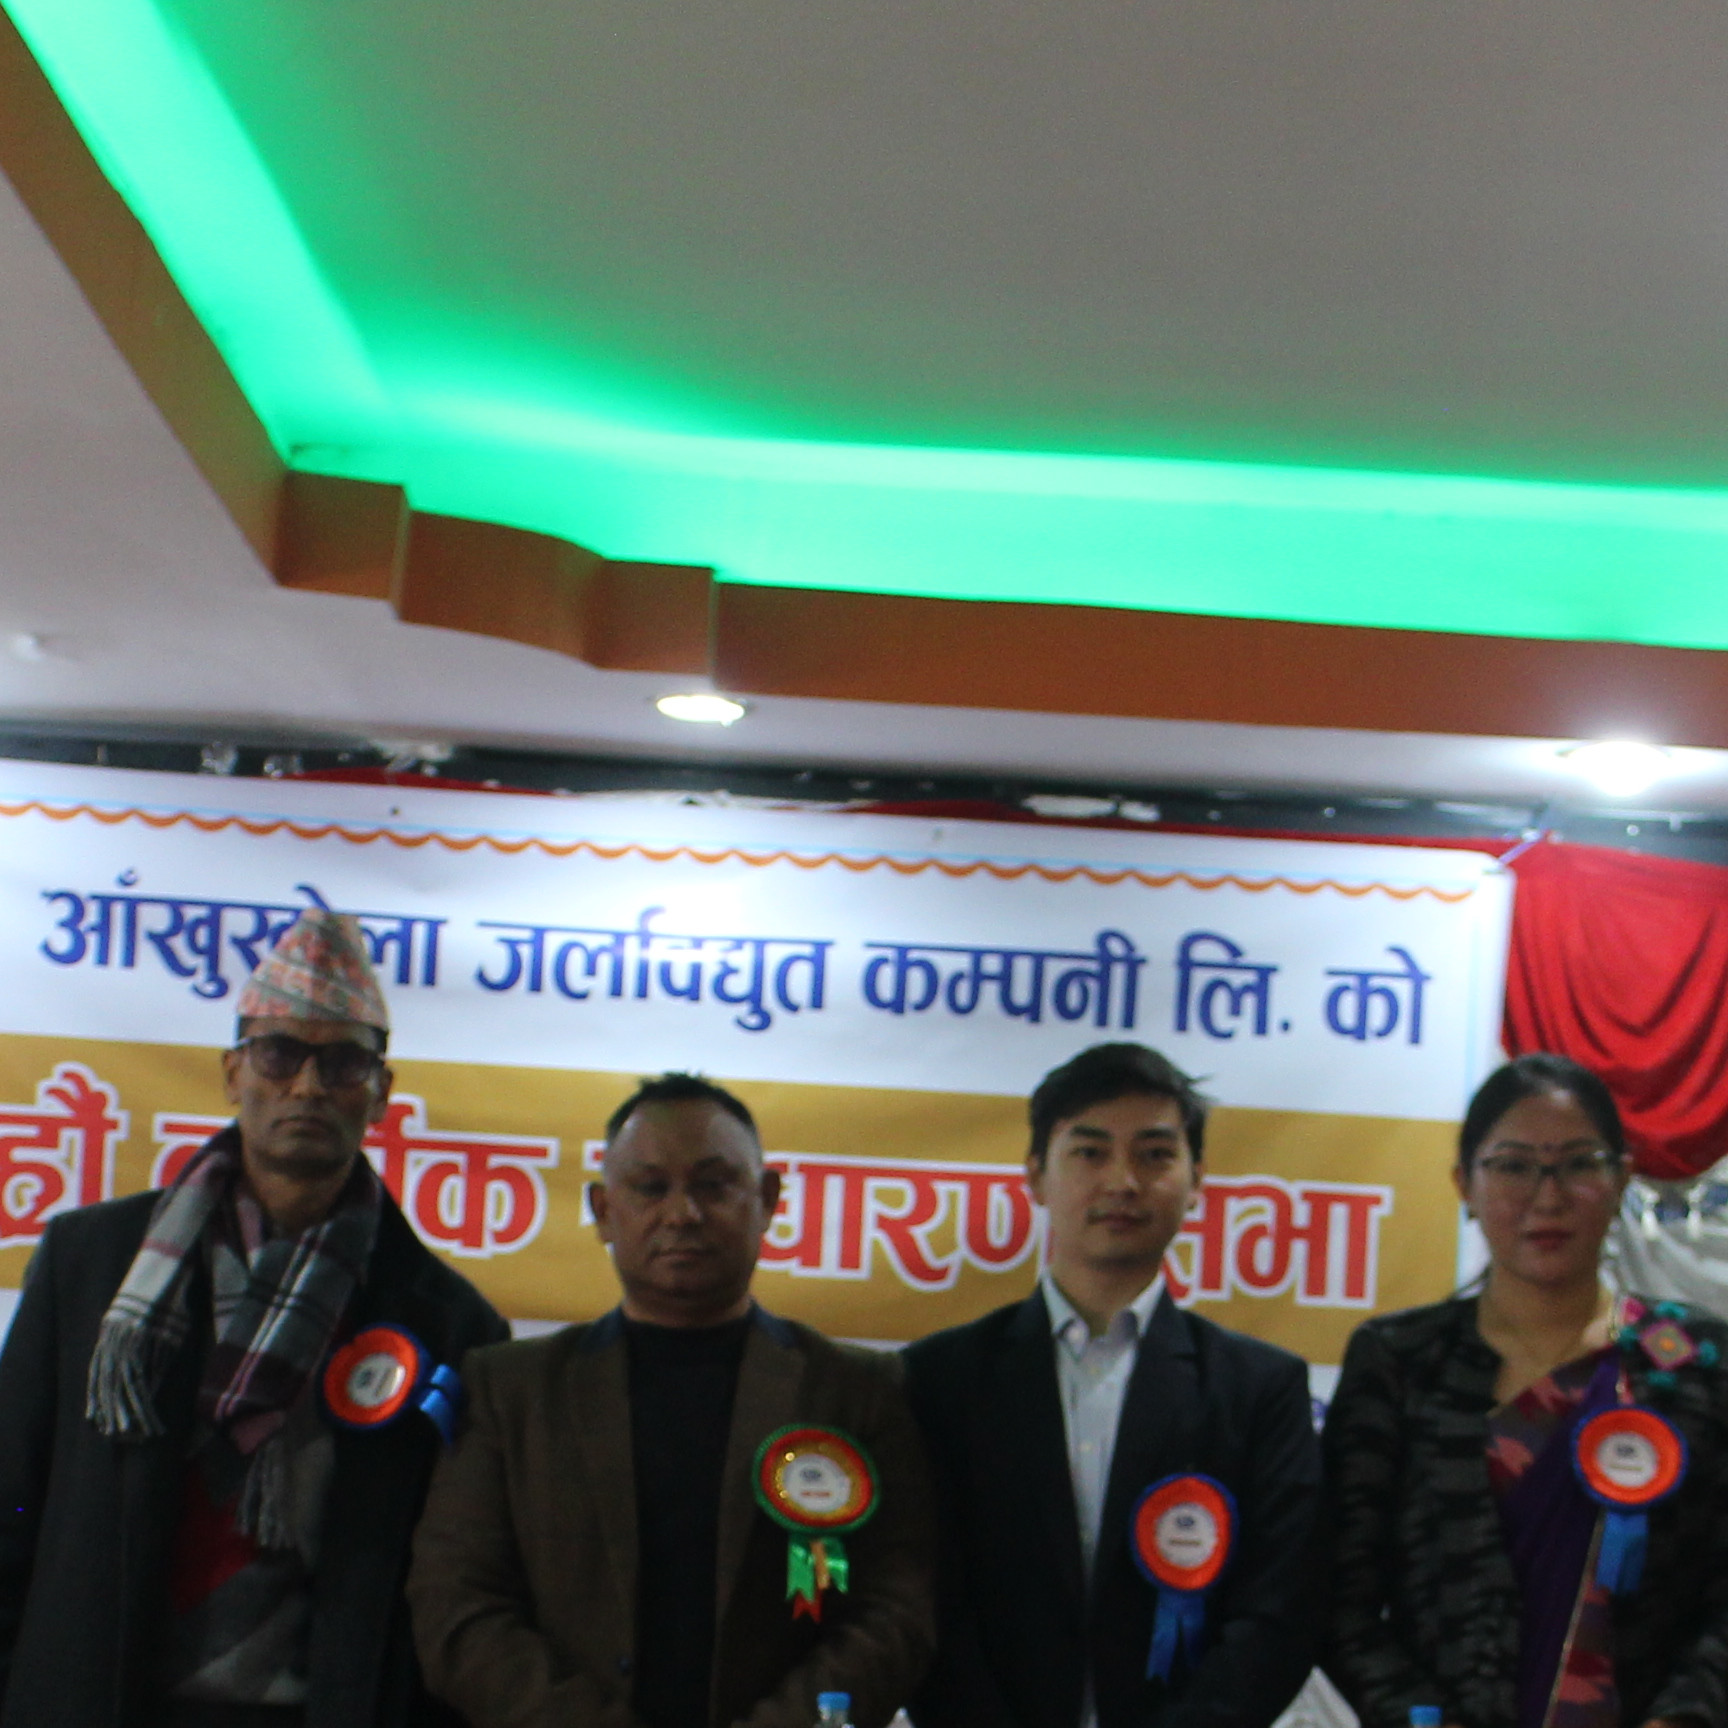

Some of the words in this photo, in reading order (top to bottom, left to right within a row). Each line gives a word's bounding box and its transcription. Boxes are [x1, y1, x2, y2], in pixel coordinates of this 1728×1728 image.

[860, 928, 1148, 1030] कम्पनी
[1174, 930, 1291, 1040] लि.
[1323, 945, 1432, 1046] को
